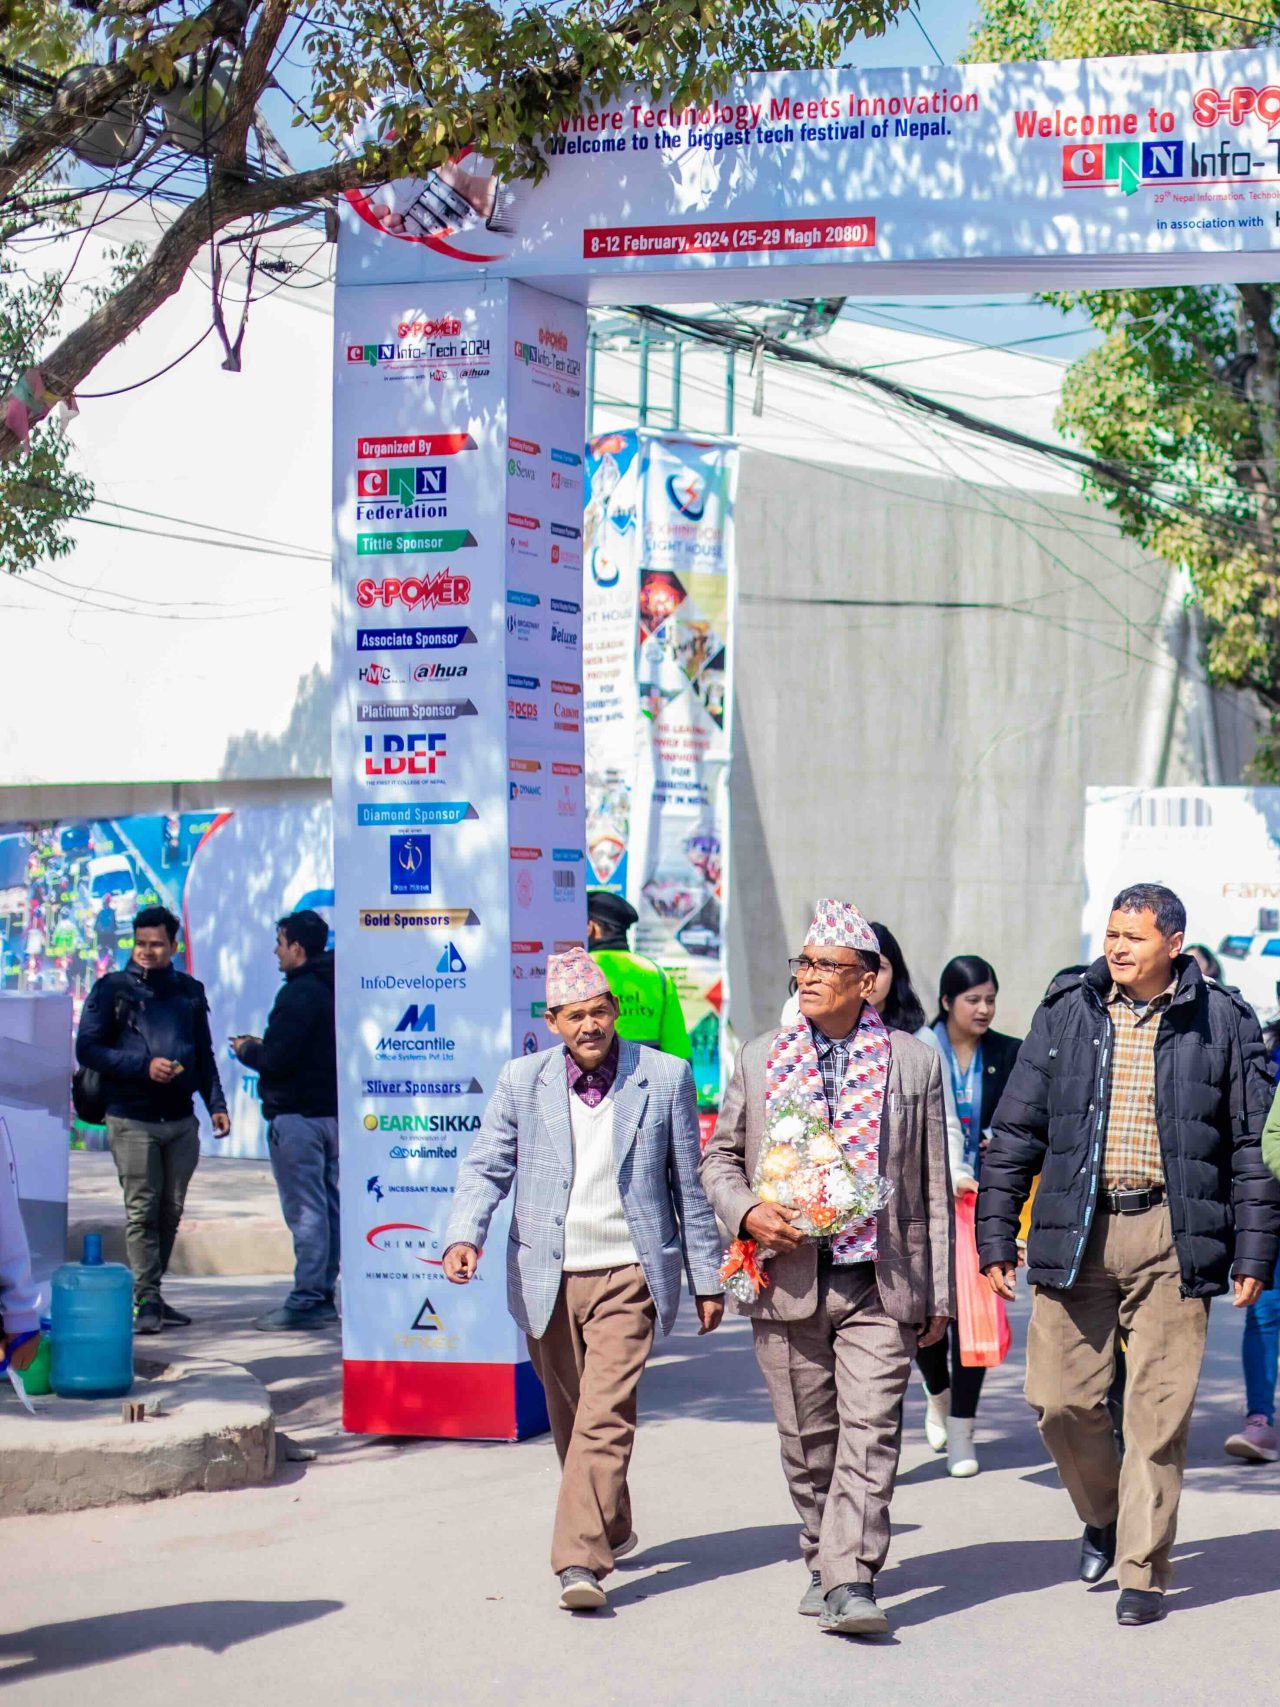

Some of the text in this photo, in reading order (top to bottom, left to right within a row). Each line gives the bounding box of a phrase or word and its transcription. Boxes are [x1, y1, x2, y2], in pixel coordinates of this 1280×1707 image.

[630, 100, 761, 130] Technology
[770, 97, 840, 120] Meets
[849, 89, 978, 117] Innovation
[1015, 107, 1138, 138] Welcome
[1148, 107, 1175, 133] to
[551, 117, 951, 155] Welcome to the biggest tech festival of Nepal.
[1173, 193, 1196, 203] Nepal
[1156, 219, 1168, 229] in
[1170, 218, 1235, 229] association
[1238, 217, 1264, 228] with
[591, 224, 868, 252] 8-12 February, 2024 (25-29 Magh 2080)
[397, 342, 457, 359] Info-Tech
[461, 339, 490, 356] 2024
[363, 439, 431, 457] Organized By
[357, 504, 447, 520] Federation
[363, 537, 443, 552] Tittle Sponsor
[357, 567, 470, 611] S-POWER
[362, 632, 458, 648] Associate Sponsor
[359, 663, 390, 685] HMC
[362, 704, 456, 719] Platinum Sponsor
[363, 808, 460, 823] Diamond Sponsor
[364, 913, 450, 928] Gold Sponsors
[360, 976, 466, 992] InfoDevelopers
[376, 1037, 455, 1050] Mercantile
[405, 1080, 461, 1096] Sponsors
[379, 1115, 481, 1131] EARNSIKKA
[384, 1240, 439, 1249] HIMMC
